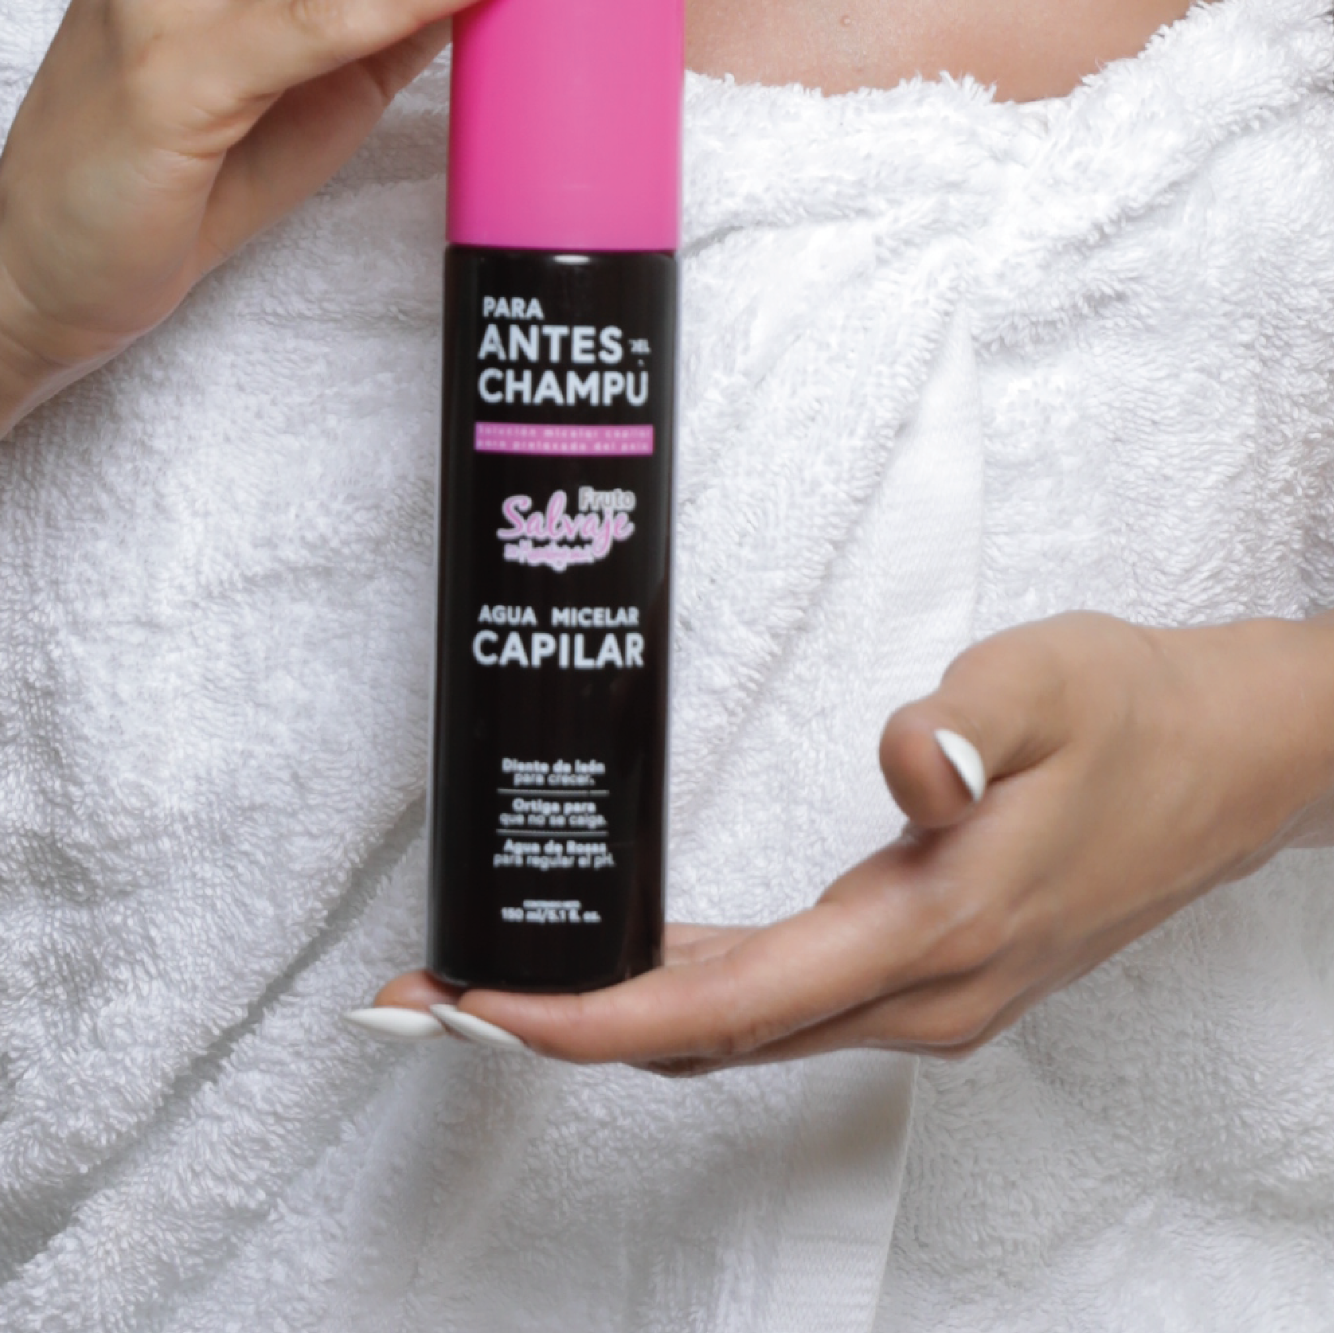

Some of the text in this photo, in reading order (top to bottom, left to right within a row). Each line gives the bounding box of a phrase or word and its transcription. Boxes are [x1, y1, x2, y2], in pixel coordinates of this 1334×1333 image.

[482, 296, 544, 320] PARA
[478, 324, 623, 364] ANTES
[478, 359, 649, 407] CHAMPÚ
[578, 486, 636, 512] Fruto
[496, 489, 636, 560] Salvaje
[478, 604, 640, 628] AGUA MICELAR
[472, 629, 645, 669] CAPILAR
[512, 798, 596, 815] Ortiga para
[527, 815, 546, 826] no
[503, 838, 541, 855] Agua
[493, 853, 524, 868] para
[526, 854, 574, 871] regular
